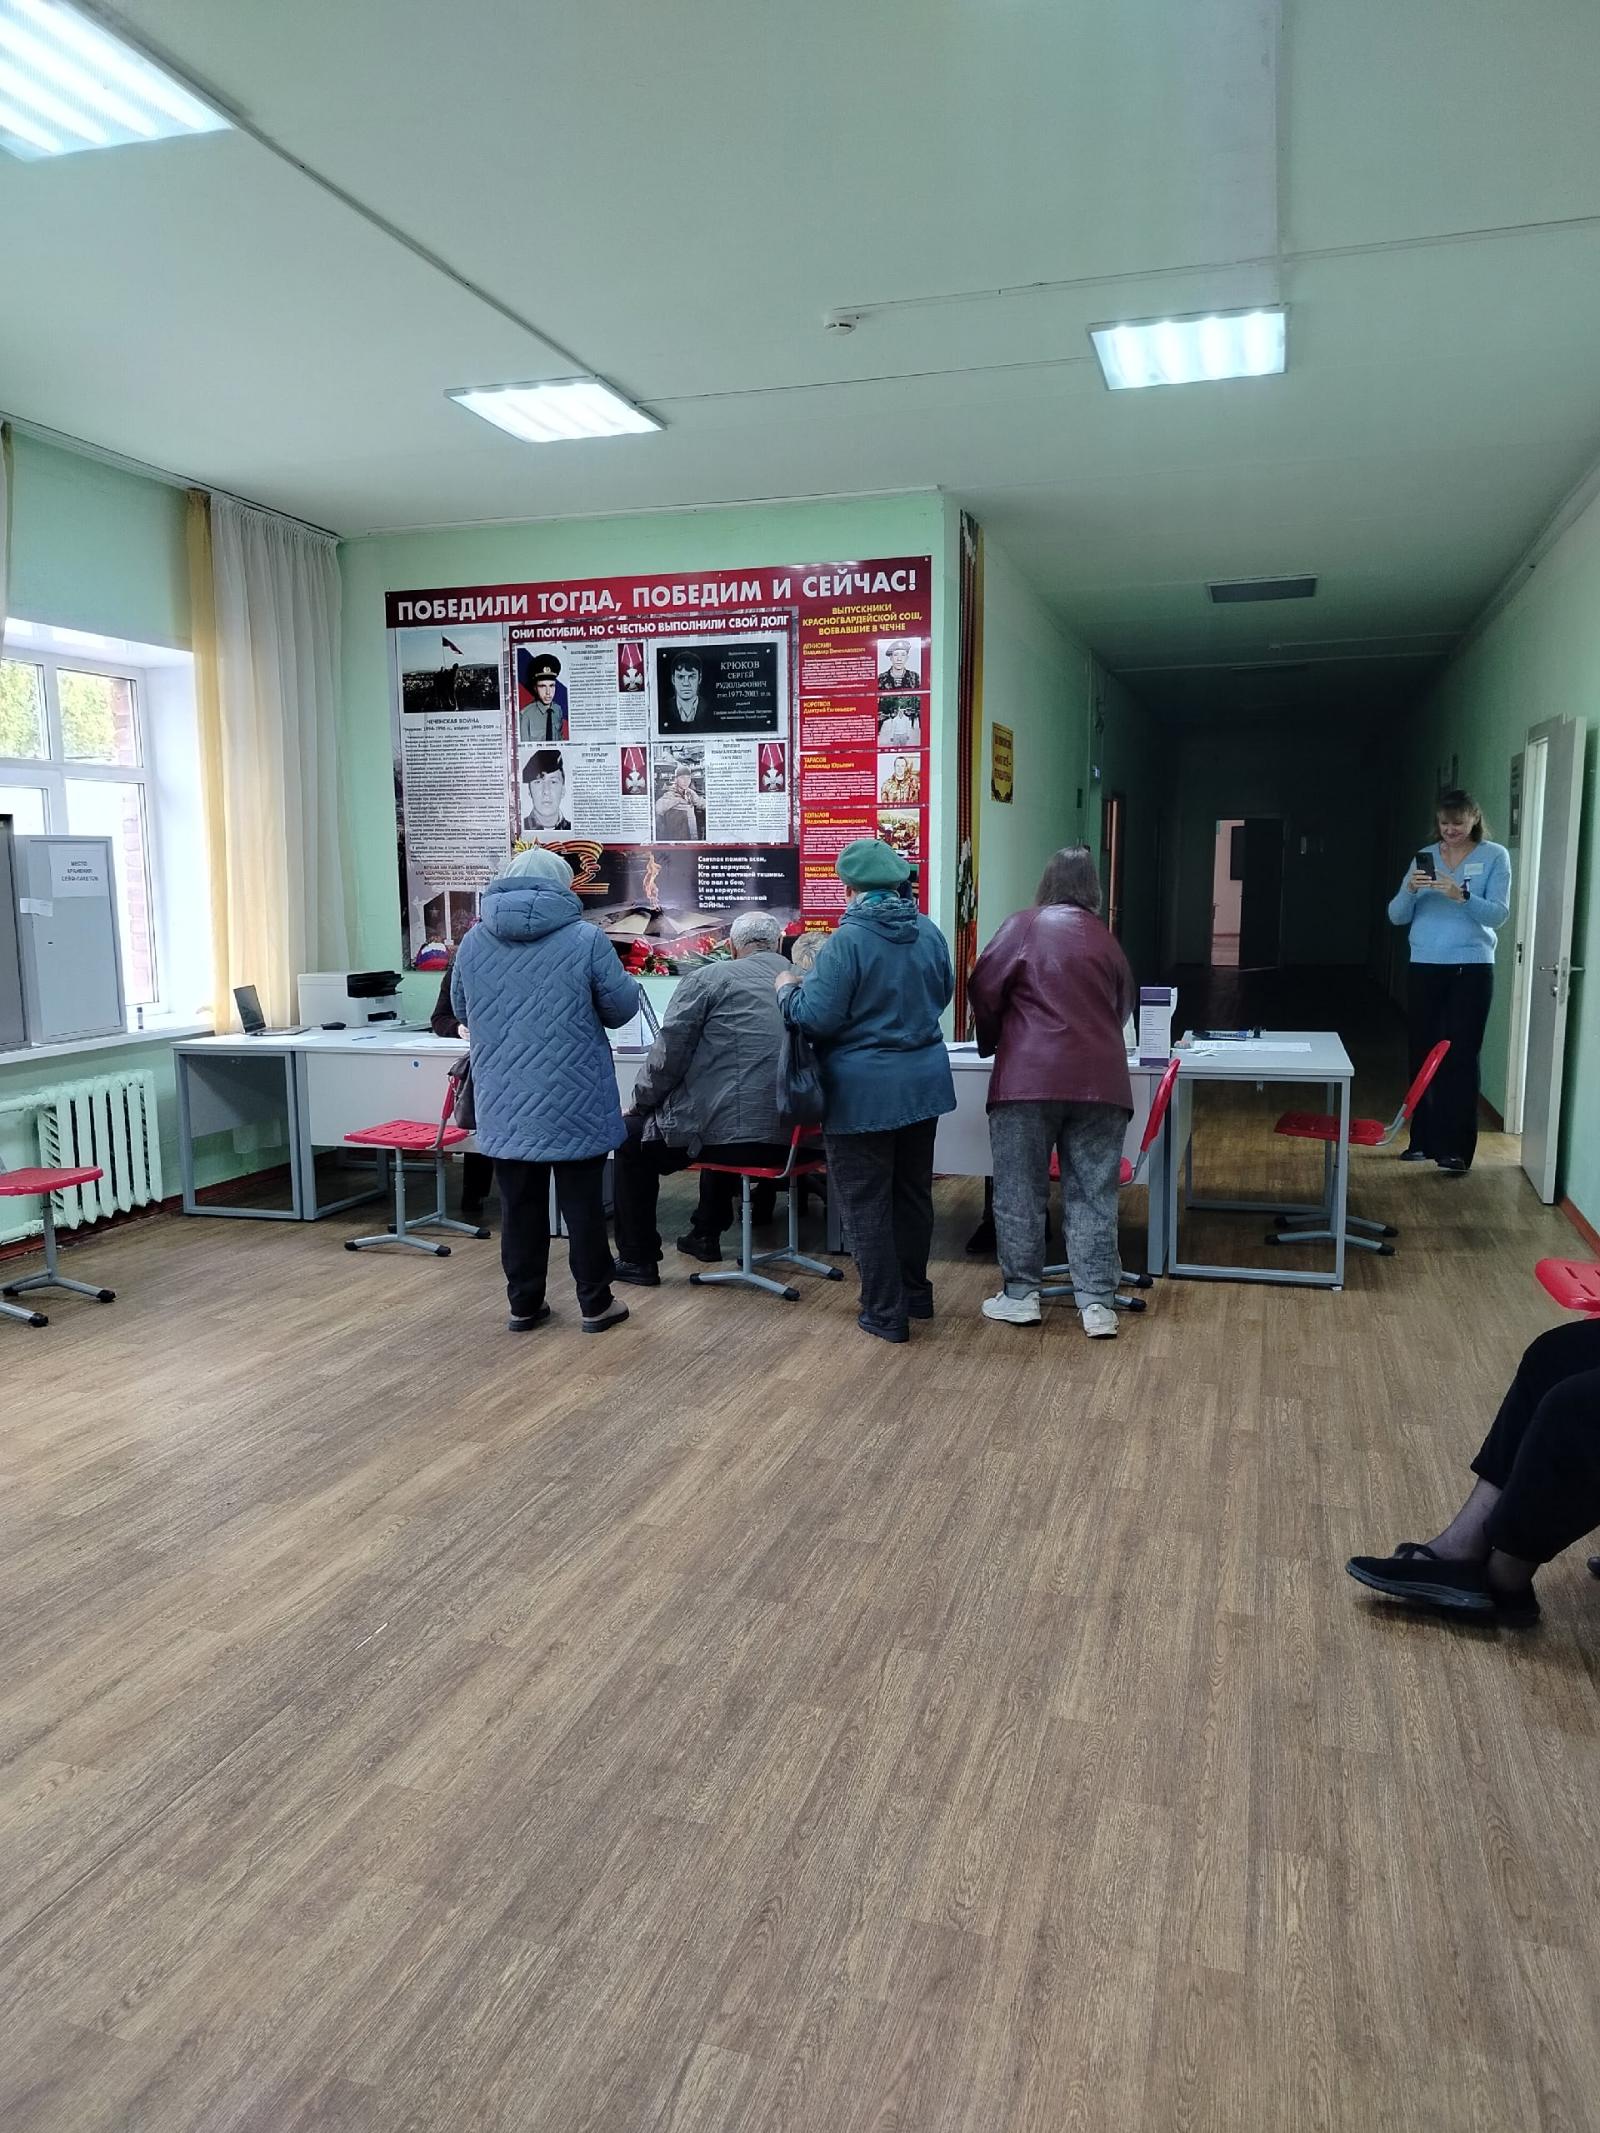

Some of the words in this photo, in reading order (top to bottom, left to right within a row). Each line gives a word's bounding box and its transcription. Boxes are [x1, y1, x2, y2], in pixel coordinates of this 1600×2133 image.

[398, 594, 528, 621] ПОБЕДИЛИ
[537, 589, 622, 614] ТОГДА,
[633, 580, 762, 608] ПОБЕДИМ
[773, 578, 791, 600] И
[802, 568, 916, 598] СЕЙЧАС!
[832, 603, 892, 615] ВЫПУСКНИКИ
[802, 612, 897, 626] КРАСНОГВАРДЕЙСКОЙ
[899, 611, 922, 620] СОШ,
[512, 628, 534, 639] ОНИ
[536, 626, 587, 638] ПОГИБЛИ,
[589, 624, 605, 636] НО
[607, 624, 614, 634] С
[616, 623, 656, 634] ЧЕСТЬЮ
[658, 619, 726, 632] ВЫПОЛНИЛИ
[728, 615, 758, 628] СВОЙ
[760, 615, 789, 628] ДОЛГ
[818, 625, 870, 635] ВОЕВАВШИЕ
[872, 625, 878, 633] В
[880, 623, 906, 632] ЧЕЧНЕ
[720, 660, 760, 671] КРЮКОВ
[728, 670, 754, 679] СЕРГЕЙ
